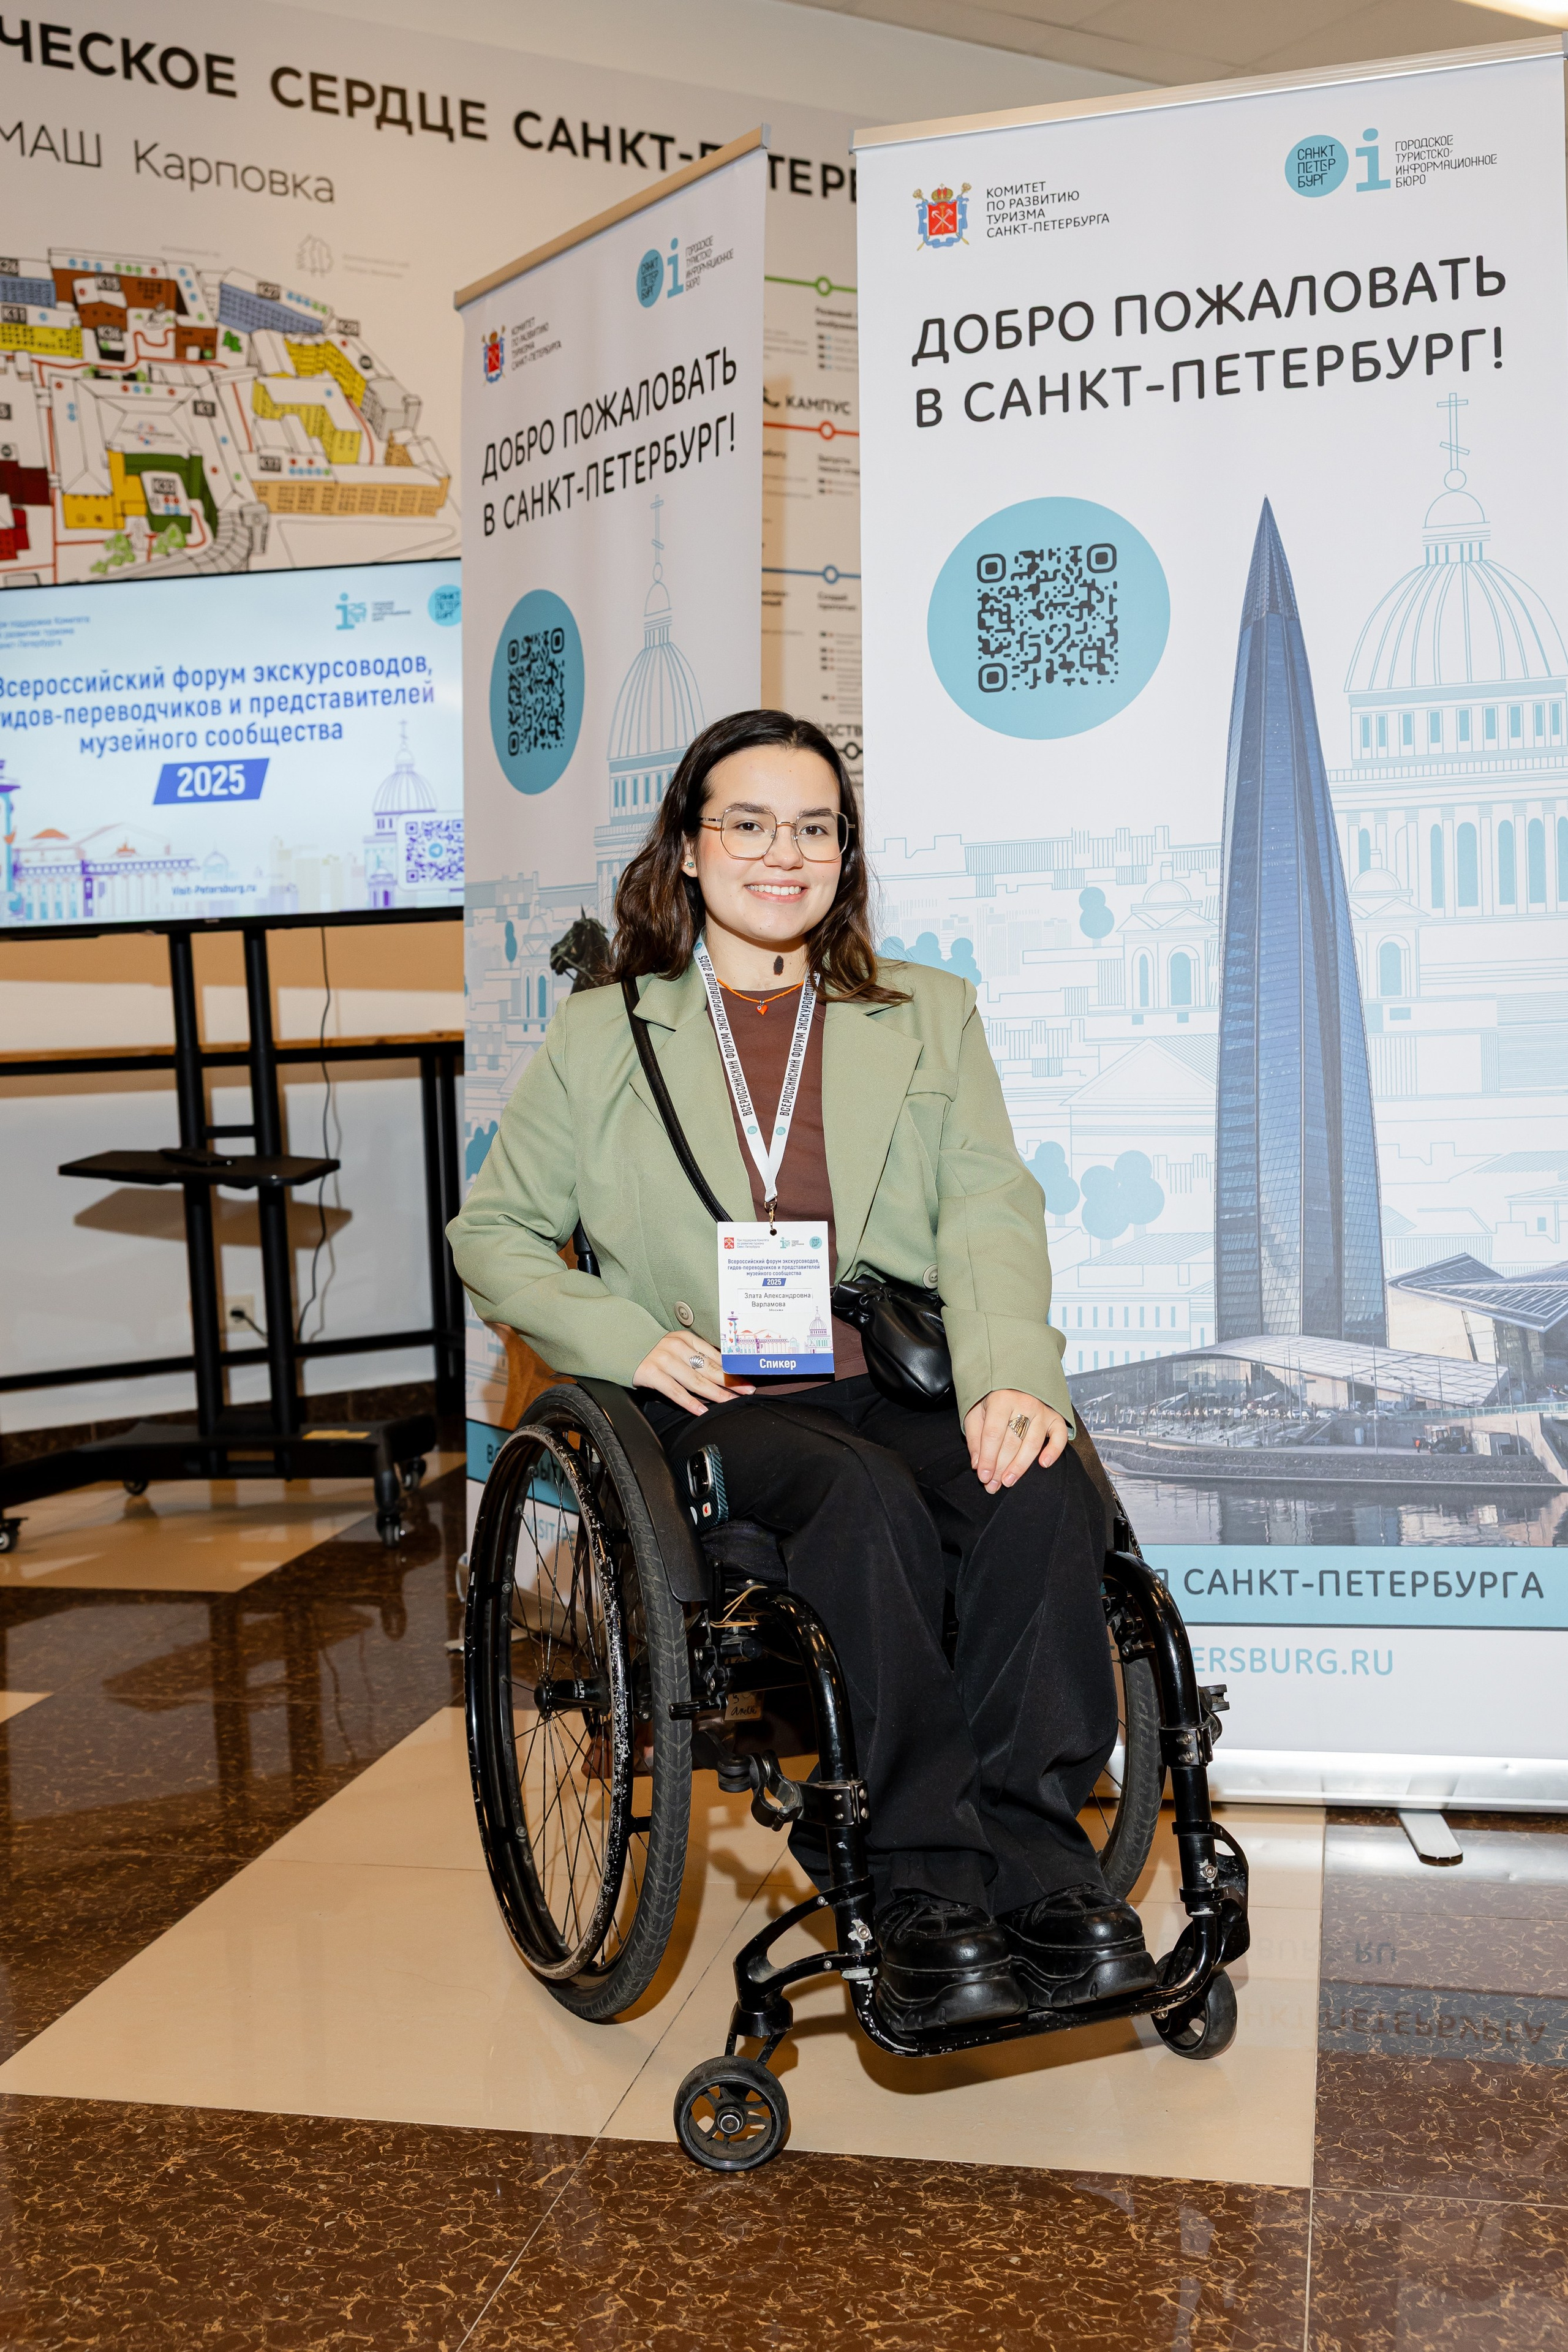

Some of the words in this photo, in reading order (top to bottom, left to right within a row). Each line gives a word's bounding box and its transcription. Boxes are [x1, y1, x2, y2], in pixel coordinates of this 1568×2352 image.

[270, 66, 489, 142] СЕРДЦЕ
[513, 110, 856, 204] САНКТ-ТЕР
[1395, 134, 1454, 153] ГОРОДСКОЕ
[1297, 144, 1335, 161] САНКТ
[1297, 158, 1336, 175] ПЕТЕР
[1395, 149, 1453, 164] ТУРИСТСКО-
[1395, 153, 1498, 176] ИНФОРМАЦИОННОЕ
[134, 138, 335, 205] Карповка
[1297, 173, 1328, 189] БУРГ
[1395, 174, 1427, 189] БЮРО
[986, 181, 1046, 198] КОМИТЕТ
[986, 200, 1005, 212] ПО
[1009, 190, 1080, 209] РАЗВИТИЮ
[987, 208, 1046, 225] ТУРИЗМА
[987, 213, 1110, 238] САНКТ-ПЕТЕРБУРГА
[911, 301, 1095, 367] ДОБРО
[1114, 255, 1506, 337] ПОЖАЛОВАТЬ
[915, 388, 943, 428] В
[963, 326, 1503, 423] САНКТ-ПЕТЕРБУРГ!
[481, 419, 554, 486] ДОБРО
[564, 346, 737, 448] ПОЖАЛОВАТЬ
[484, 502, 495, 537] В
[503, 412, 735, 530] САНКТ-ПЕТЕРБУРГ!
[173, 665, 246, 692] форум
[253, 655, 432, 685] экскурсоводов,
[230, 698, 241, 714] и
[250, 679, 434, 717] представителей
[80, 728, 197, 758] музейного
[206, 722, 343, 745] сообщества
[177, 764, 245, 797] 2025
[698, 955, 712, 971] 2025
[706, 973, 729, 1031] ЭКСКУРСОВОДОВ
[721, 1033, 736, 1059] ФОРУМ
[779, 1059, 801, 1116] ВСЕРОССИЙСКИЙ
[791, 1032, 807, 1057] ФОРУМ
[726, 1060, 753, 1117] ВСЕРОССИЙСКИЙ
[760, 1358, 796, 1370] Спикер
[1183, 1568, 1544, 1599] САНКТ-ПЕТЕРБУРГА
